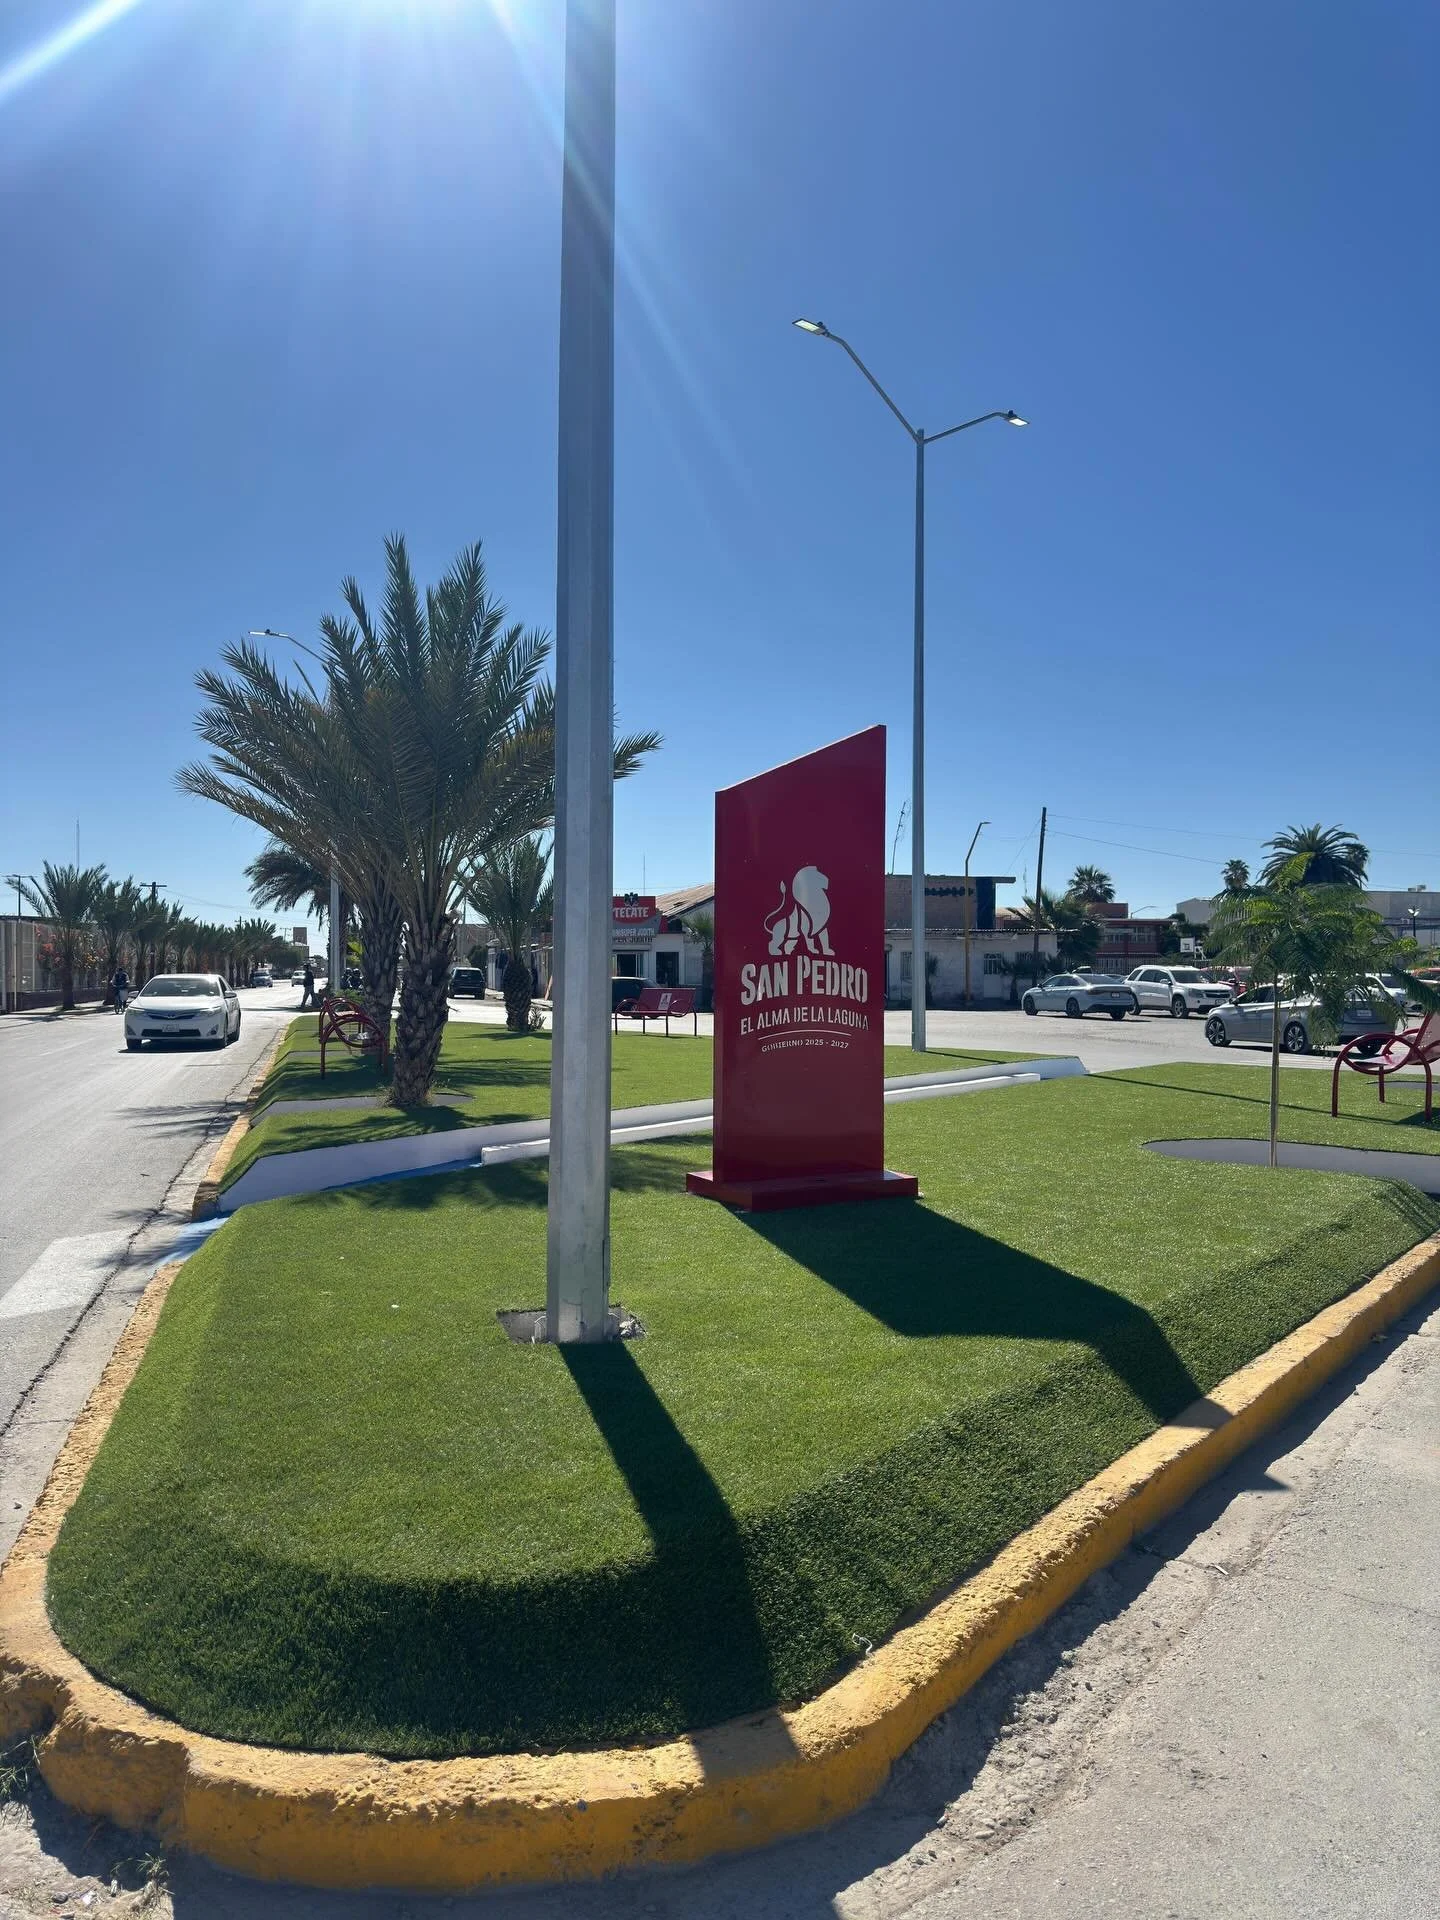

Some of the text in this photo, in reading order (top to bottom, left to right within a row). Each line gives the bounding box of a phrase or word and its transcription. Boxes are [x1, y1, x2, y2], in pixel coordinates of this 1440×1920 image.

[613, 906, 649, 918] TECATE
[741, 955, 868, 1005] SAN PEDRO
[740, 1005, 868, 1036] EL ALMA DE LA LAGUNA
[805, 1038, 824, 1046] 2025
[830, 1039, 849, 1049] 2027
